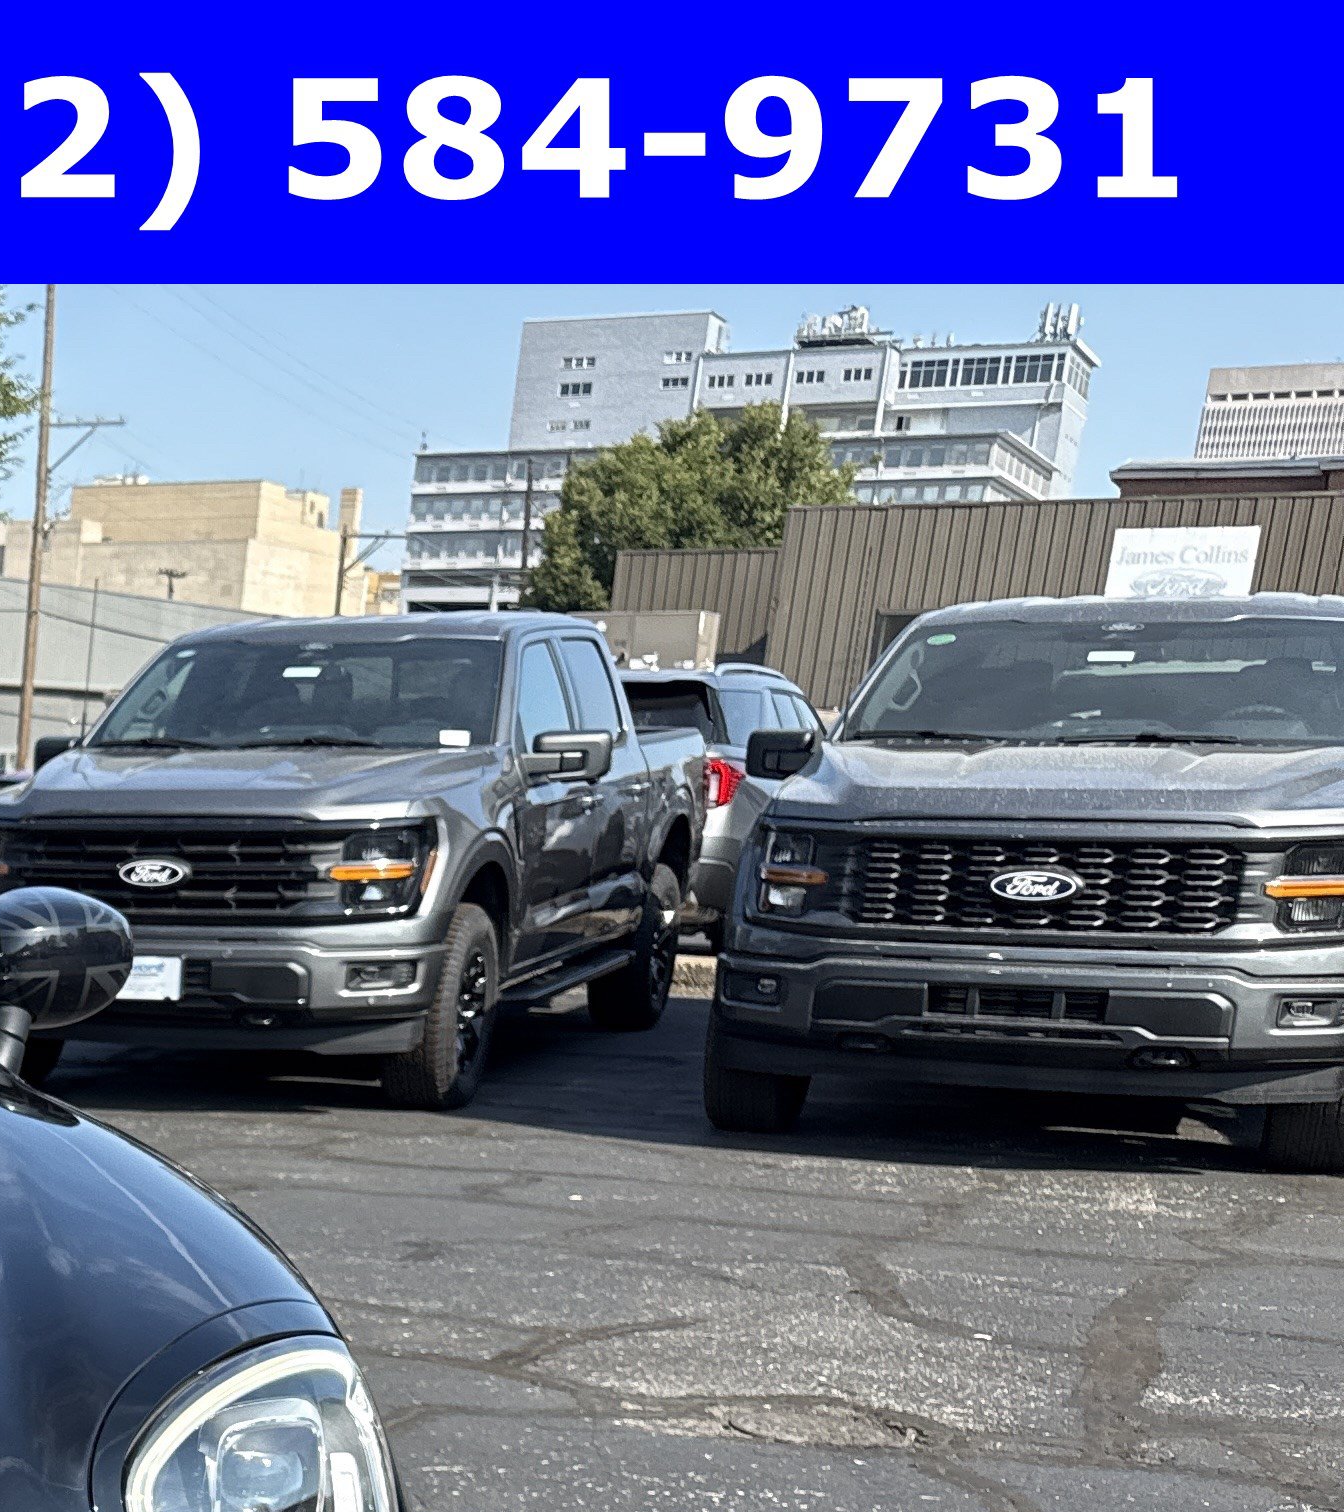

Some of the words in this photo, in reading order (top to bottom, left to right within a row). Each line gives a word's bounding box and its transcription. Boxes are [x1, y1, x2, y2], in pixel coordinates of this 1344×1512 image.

[1116, 545, 1175, 566] James
[1179, 545, 1249, 565] Collins
[129, 864, 174, 883] Ford
[1004, 874, 1062, 897] Ford
